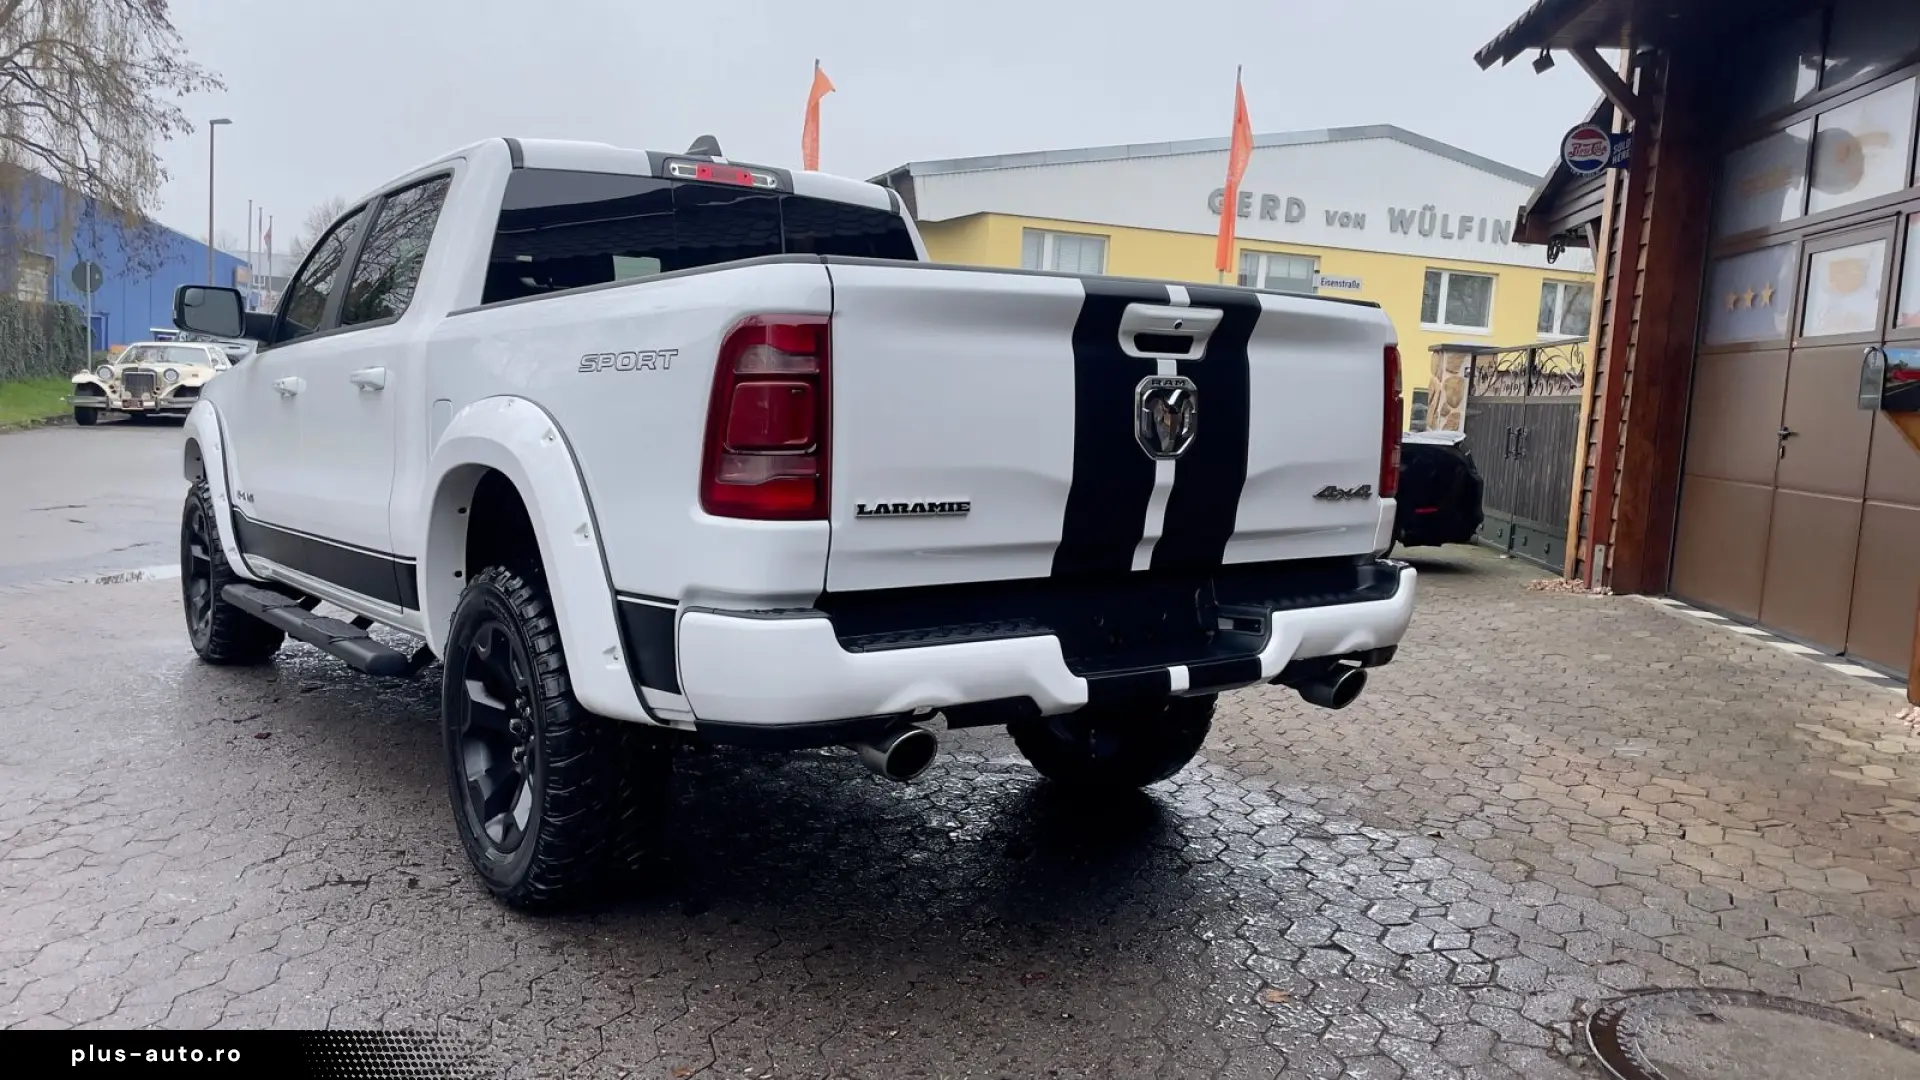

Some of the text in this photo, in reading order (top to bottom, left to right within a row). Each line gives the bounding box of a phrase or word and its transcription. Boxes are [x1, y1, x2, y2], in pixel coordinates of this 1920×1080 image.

[1388, 203, 1528, 246] WÜLFIN
[1320, 276, 1360, 289] Eisenstraße
[578, 348, 679, 372] SPORT
[1151, 379, 1186, 387] RAM
[856, 501, 971, 516] LARAMIE
